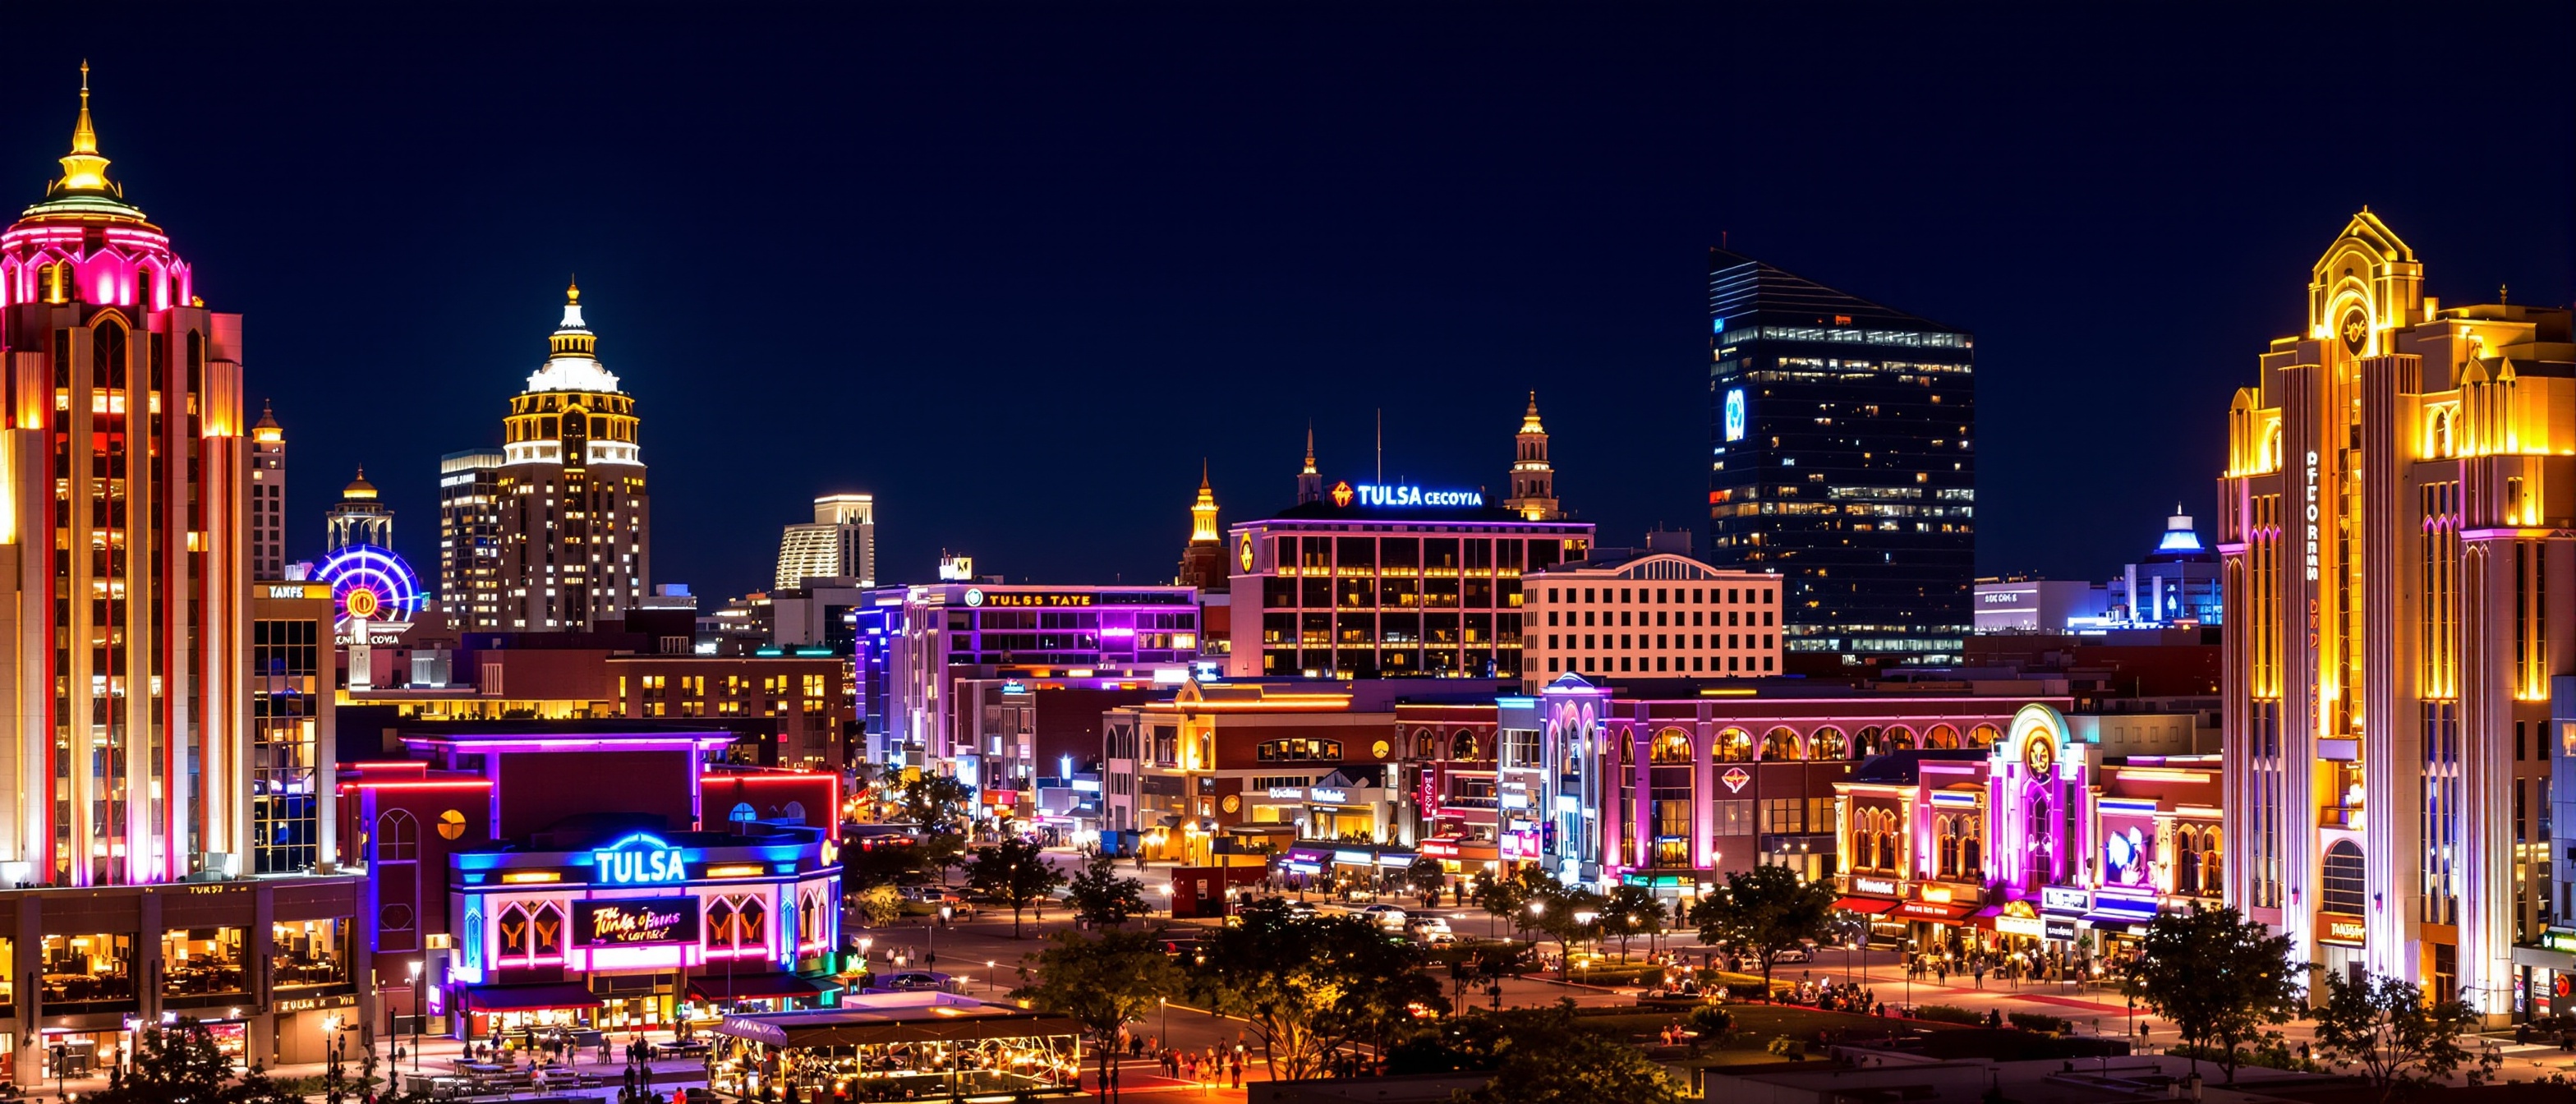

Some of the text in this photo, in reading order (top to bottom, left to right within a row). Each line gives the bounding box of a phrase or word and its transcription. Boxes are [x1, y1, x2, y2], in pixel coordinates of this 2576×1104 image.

[1357, 485, 1483, 506] TULSA CECOYIA
[596, 850, 686, 883] TULSA
